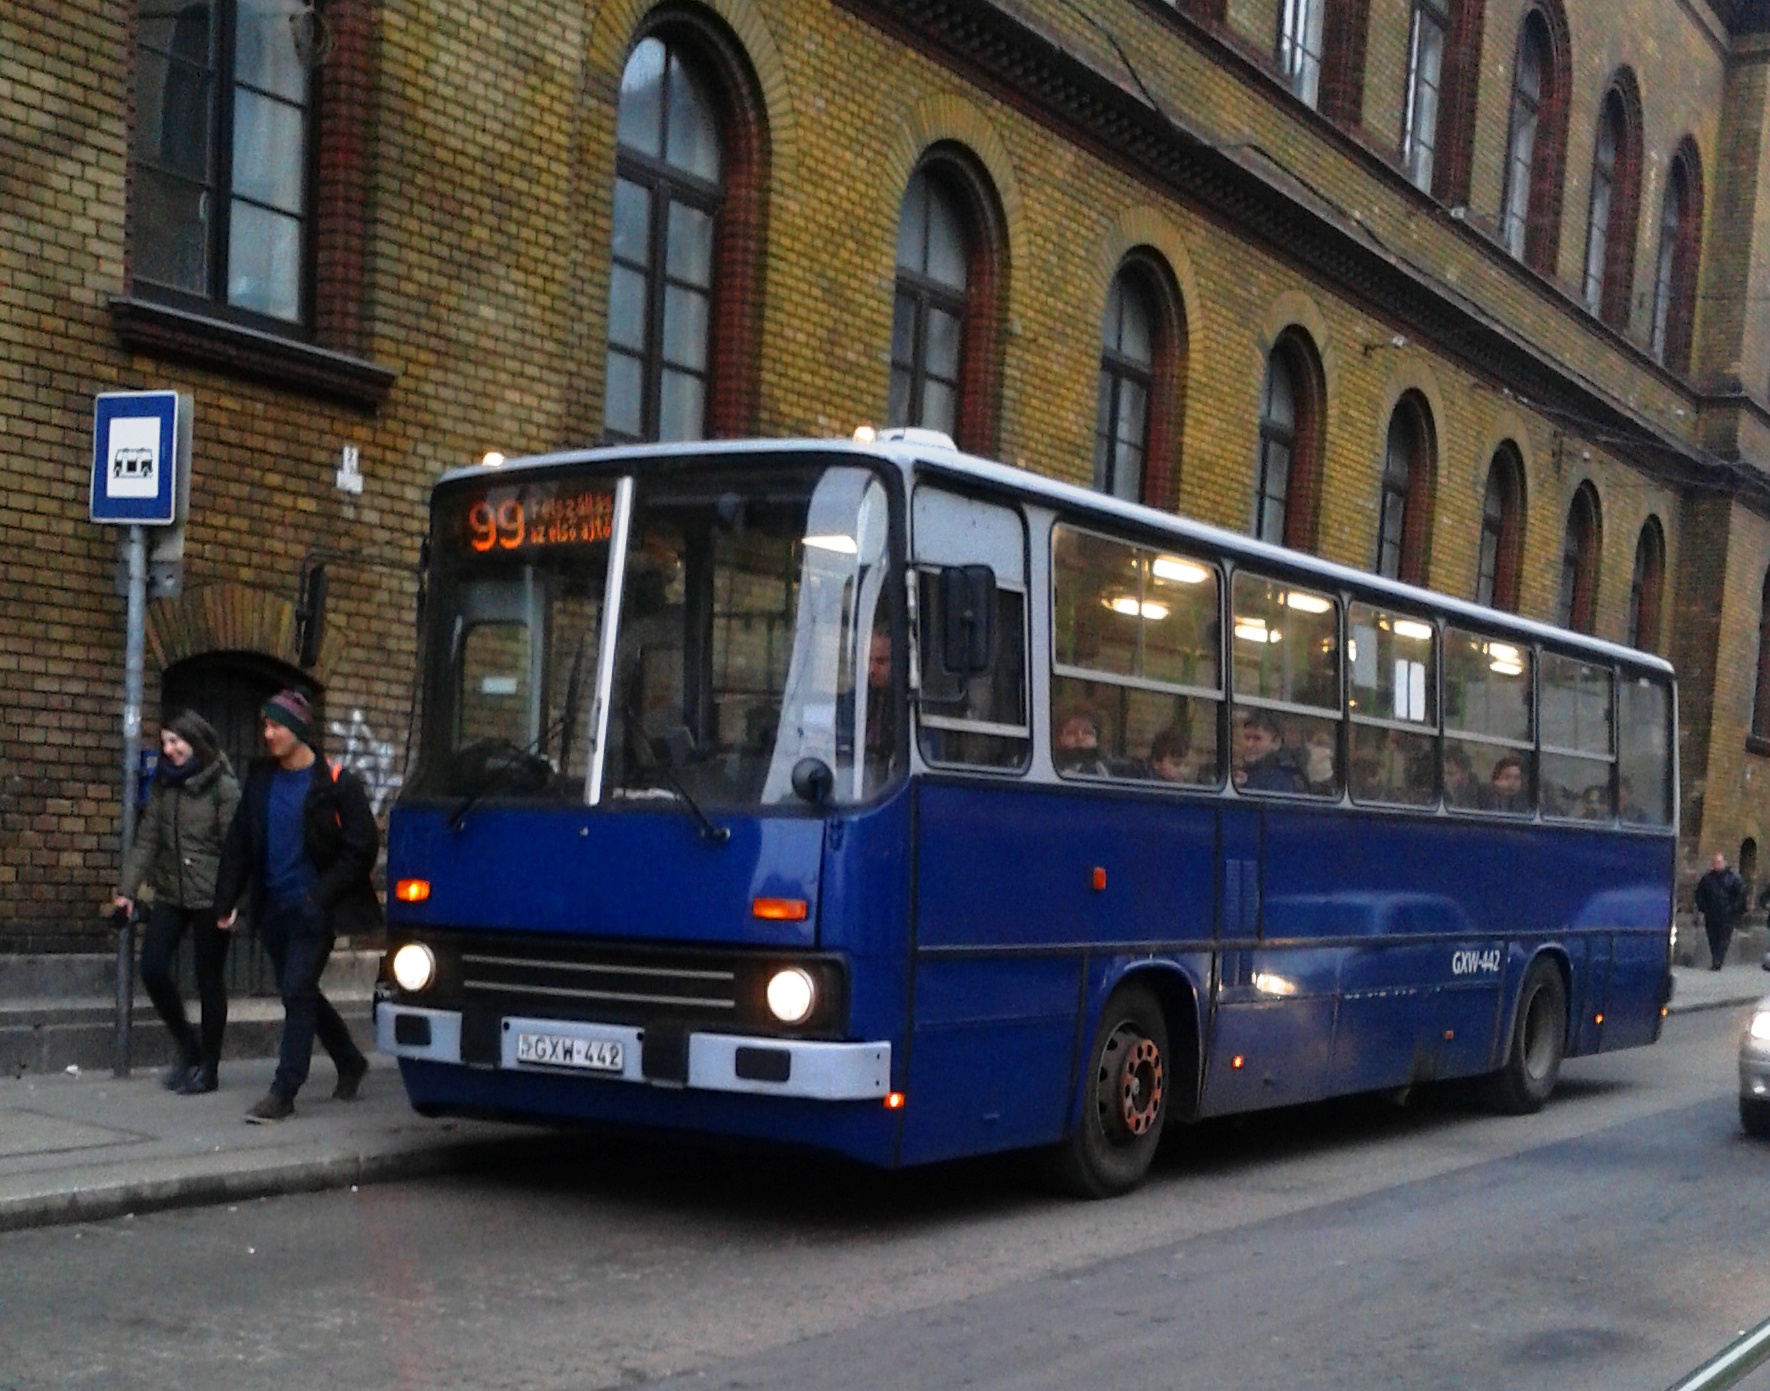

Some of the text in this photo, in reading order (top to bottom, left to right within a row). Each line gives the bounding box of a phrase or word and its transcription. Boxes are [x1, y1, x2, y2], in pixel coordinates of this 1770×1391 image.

[469, 500, 525, 552] 99
[1452, 949, 1501, 975] GXW-442
[534, 1037, 620, 1066] GXW-442
